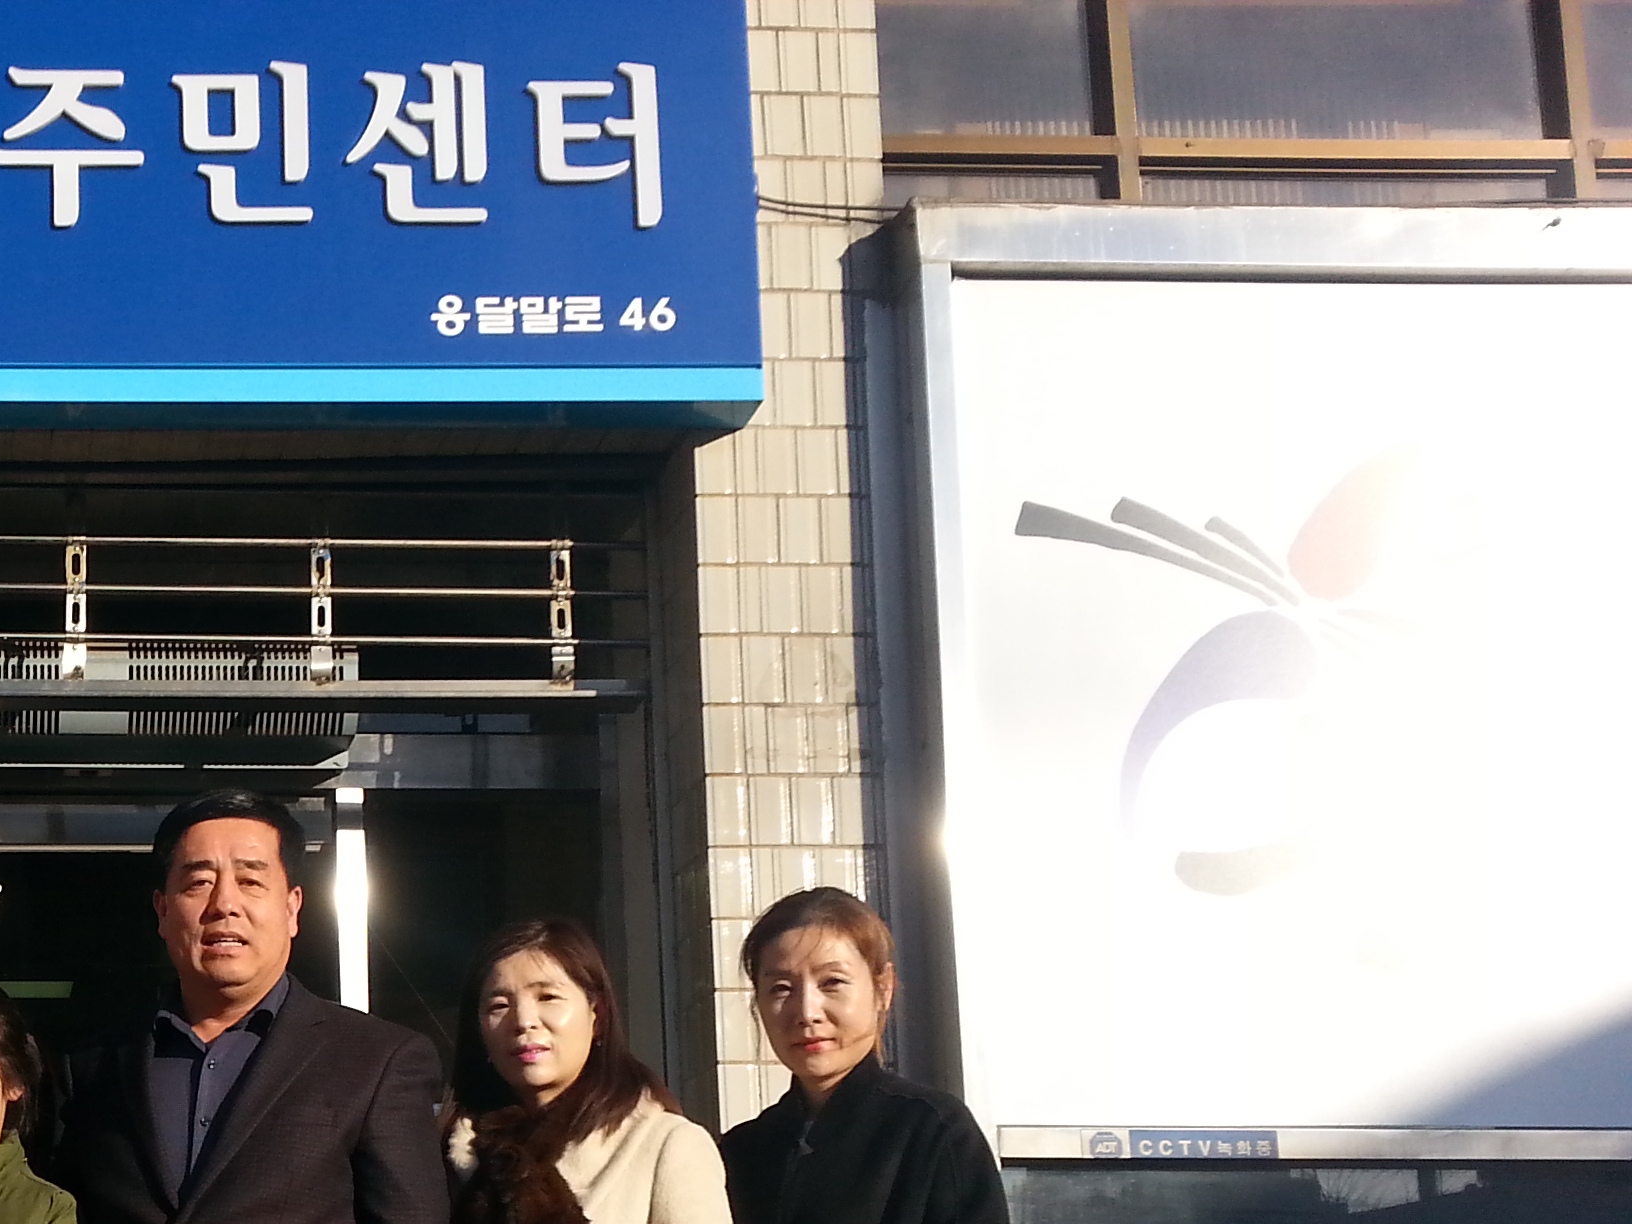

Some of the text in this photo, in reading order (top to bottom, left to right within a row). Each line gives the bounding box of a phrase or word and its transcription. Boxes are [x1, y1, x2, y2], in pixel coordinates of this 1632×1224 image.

[430, 293, 677, 337] 응달말로 46
[1096, 1142, 1117, 1154] ADT
